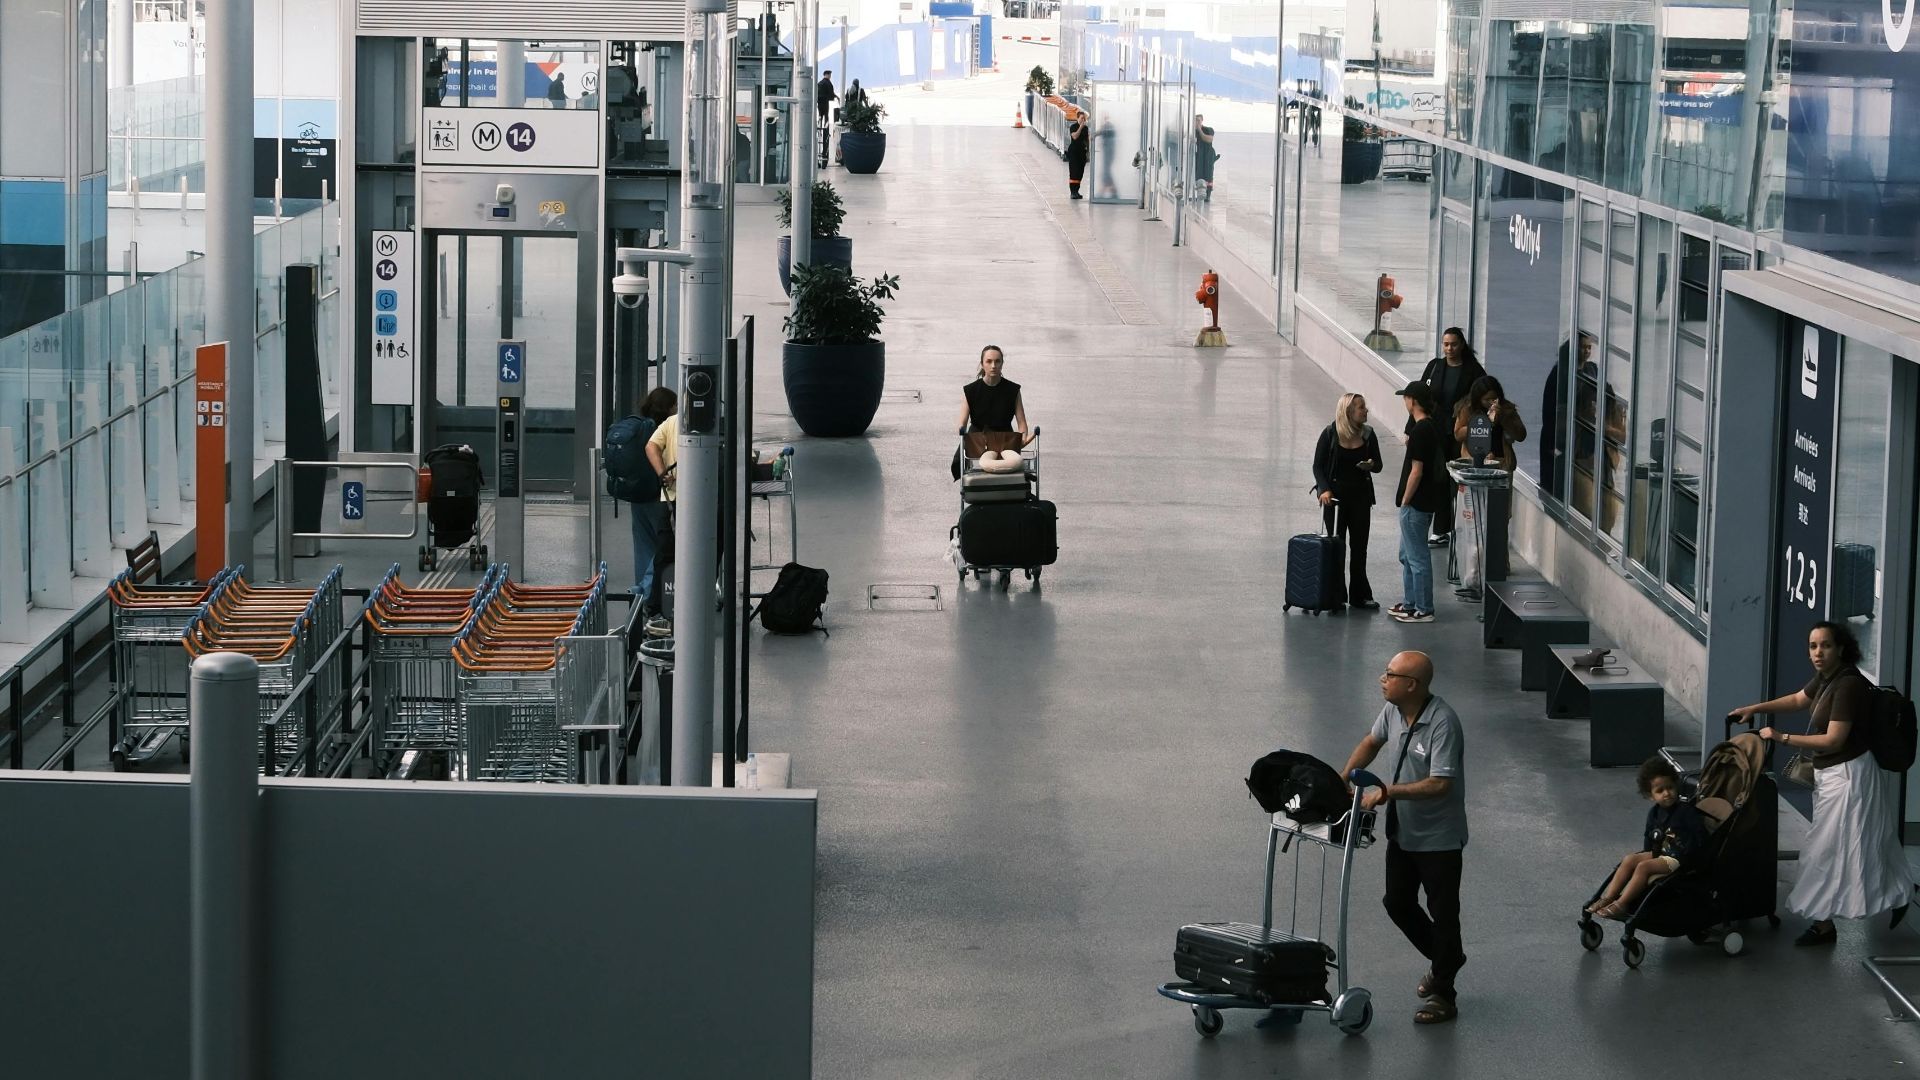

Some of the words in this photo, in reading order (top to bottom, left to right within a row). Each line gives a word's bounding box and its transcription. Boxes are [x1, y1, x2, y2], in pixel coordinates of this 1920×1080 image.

[479, 128, 495, 145] M
[509, 128, 532, 146] 14
[381, 239, 393, 251] M
[378, 263, 395, 276] 14
[1470, 427, 1489, 435] NON
[1795, 428, 1818, 458] Arrivées
[1794, 464, 1816, 493] Arrivals
